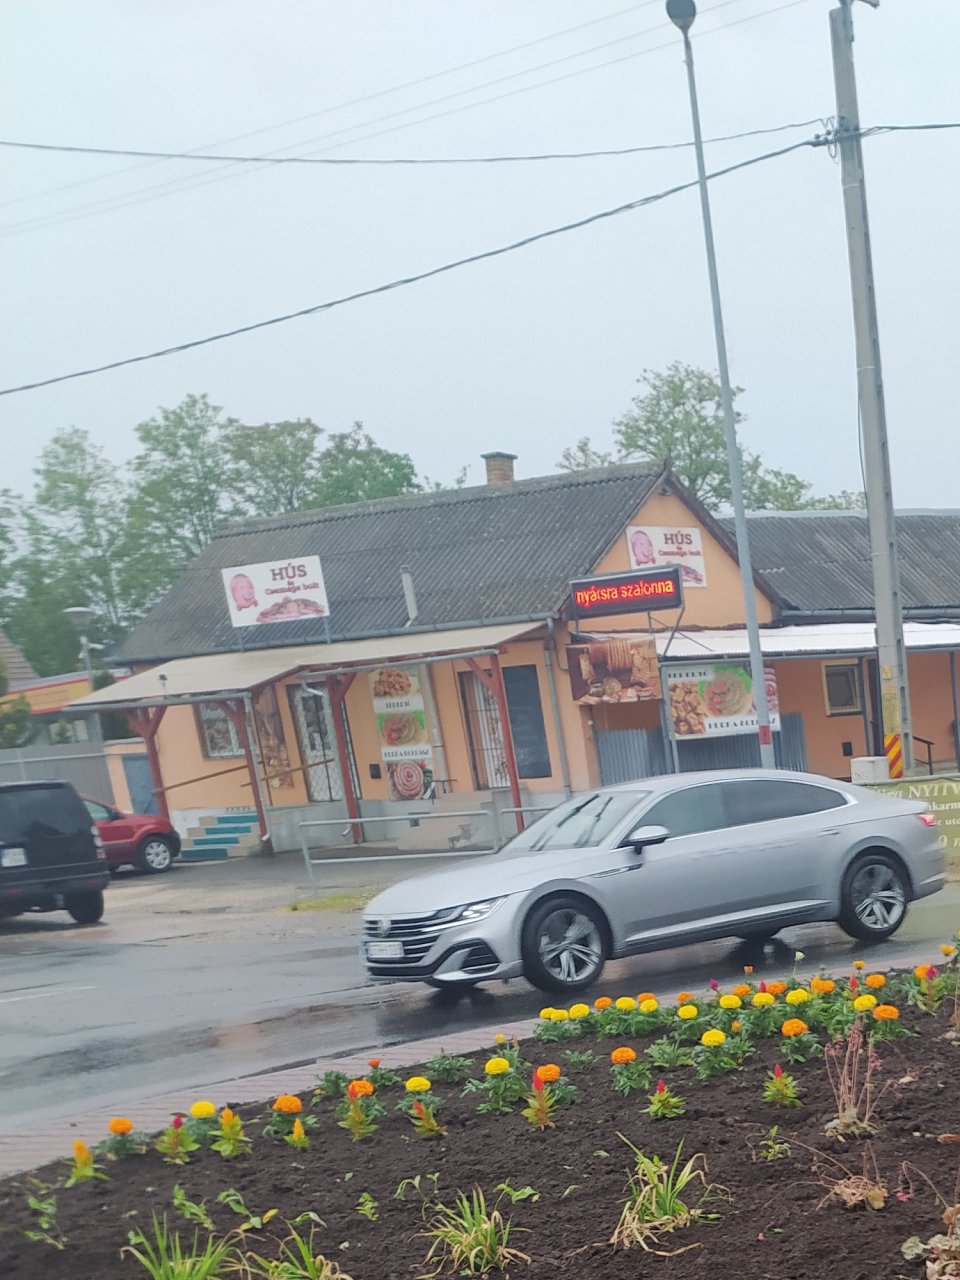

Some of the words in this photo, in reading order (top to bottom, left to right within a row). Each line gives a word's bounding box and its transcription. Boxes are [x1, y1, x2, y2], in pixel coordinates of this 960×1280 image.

[663, 530, 693, 545] HÚS
[271, 562, 307, 581] HÚS
[620, 580, 674, 598] szalonna
